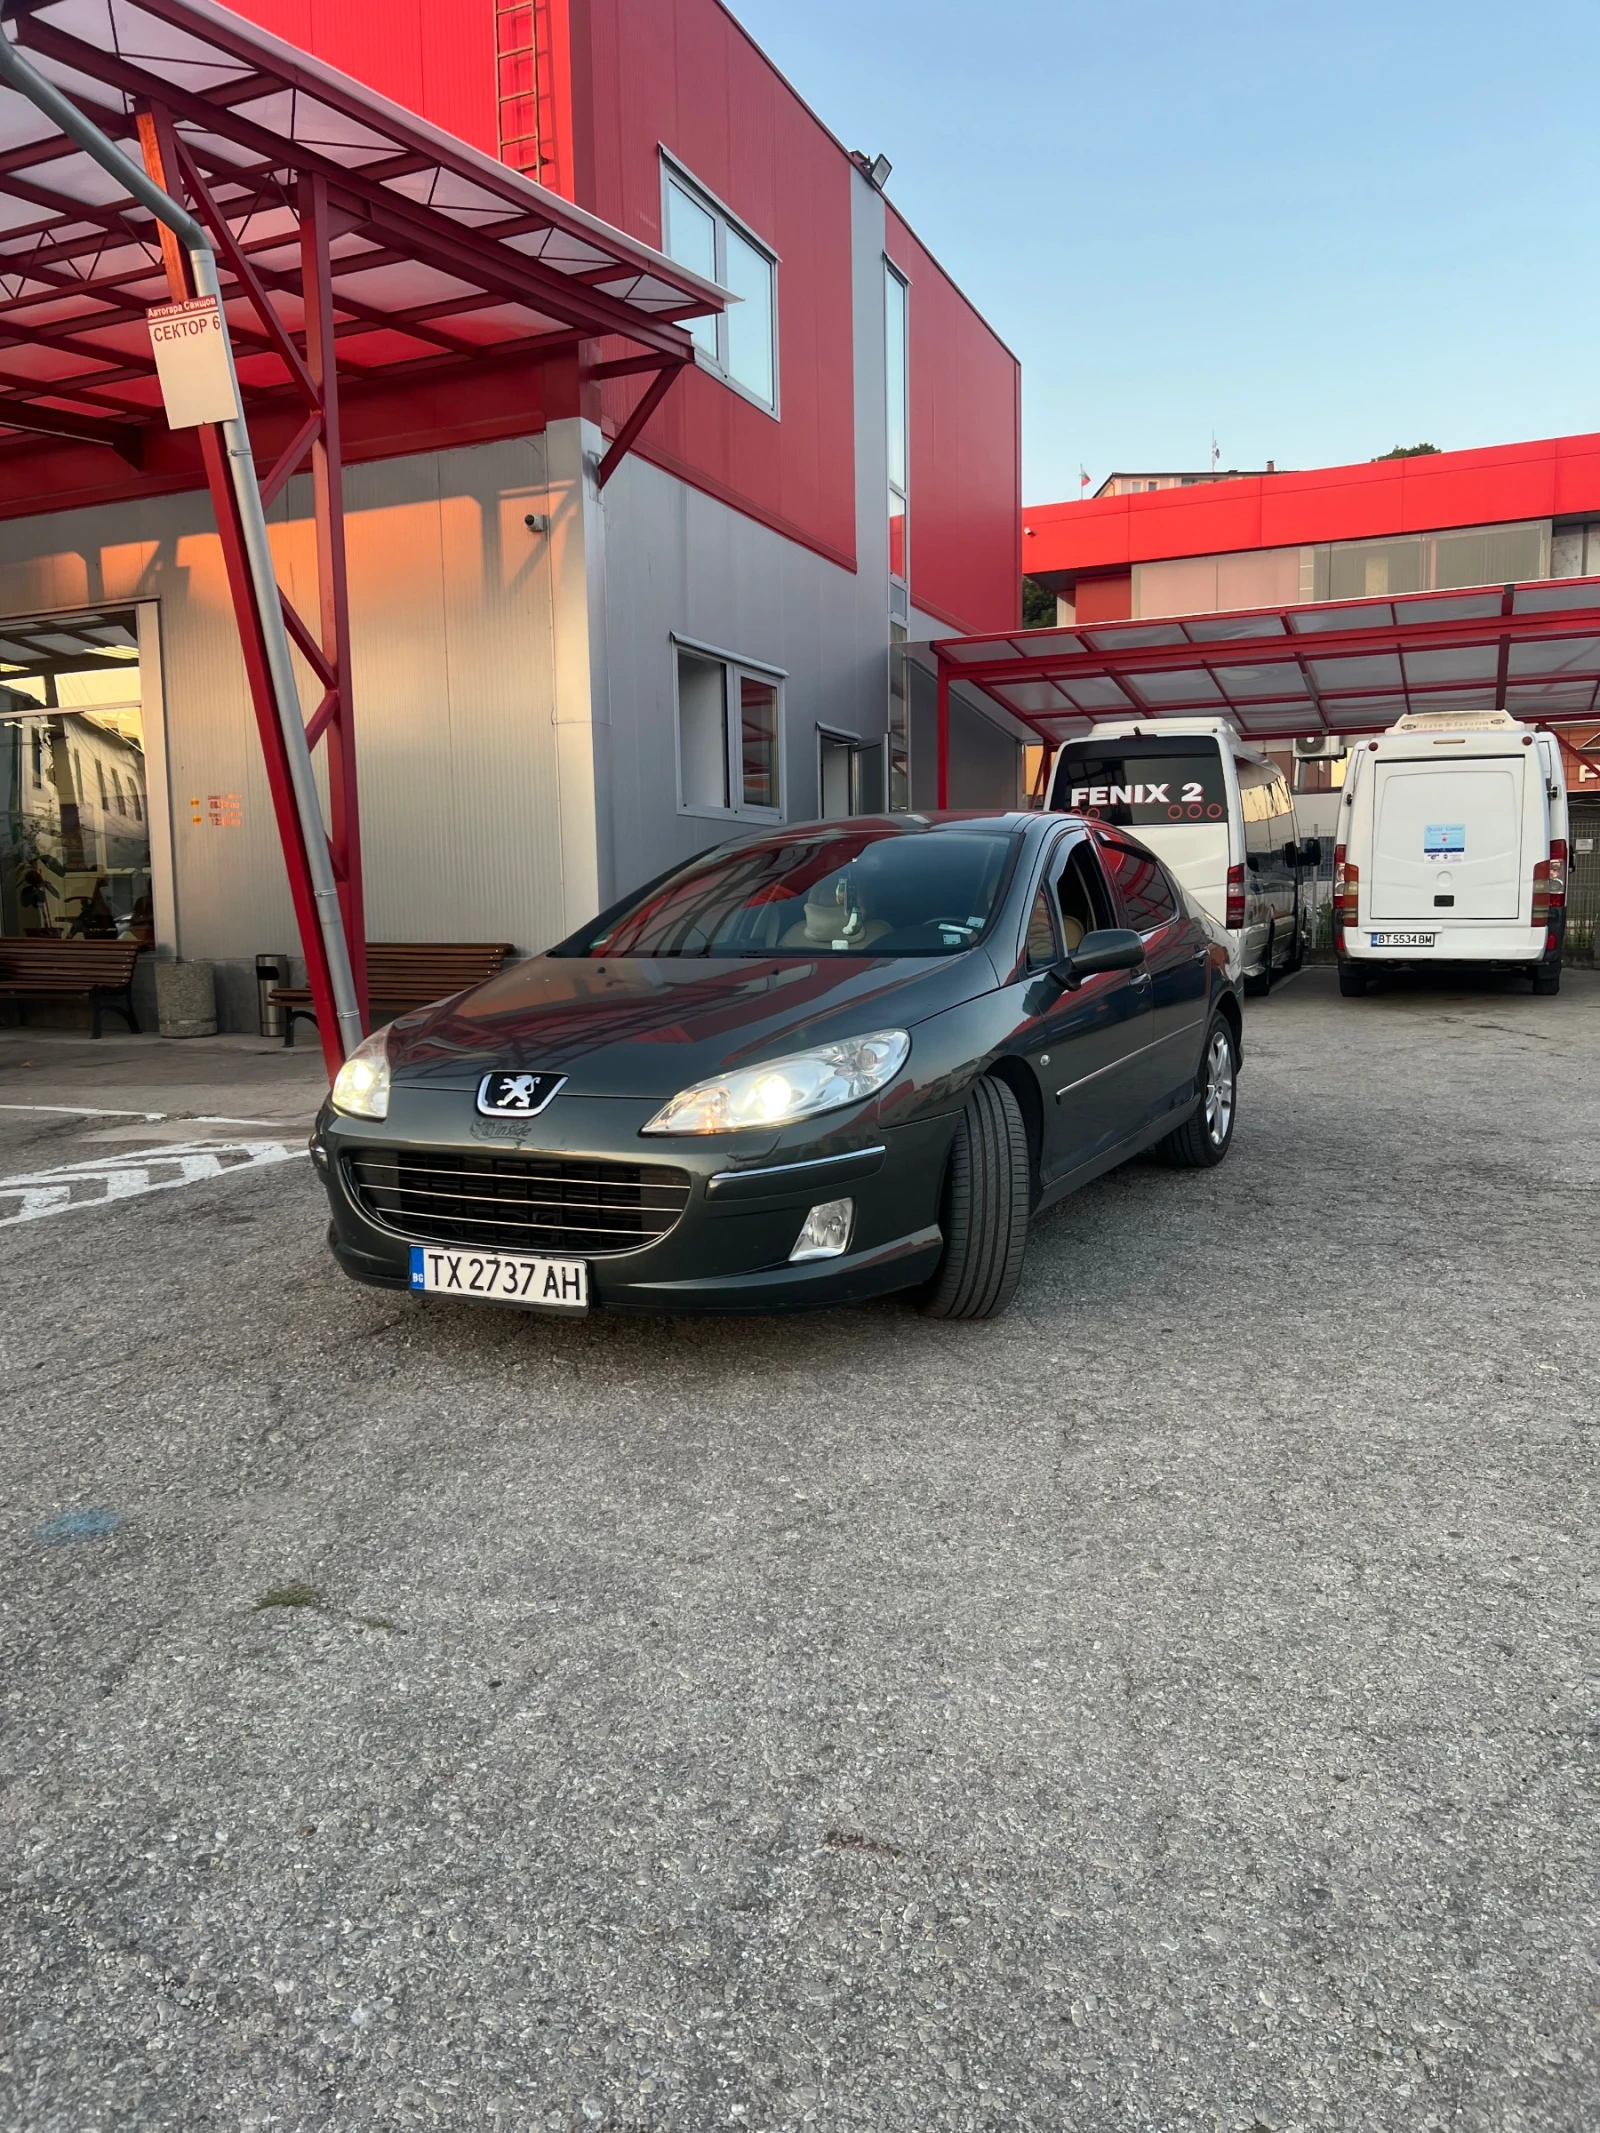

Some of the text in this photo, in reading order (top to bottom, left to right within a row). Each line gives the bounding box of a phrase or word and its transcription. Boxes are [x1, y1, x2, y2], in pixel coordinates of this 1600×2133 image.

[148, 297, 216, 318] Автогара Свищов
[154, 315, 221, 342] СЕКТОР 6
[1071, 782, 1204, 807] FENIX 2
[1378, 934, 1432, 944] BT 5534 BM
[412, 1254, 581, 1301] BG TX 2737 AH
